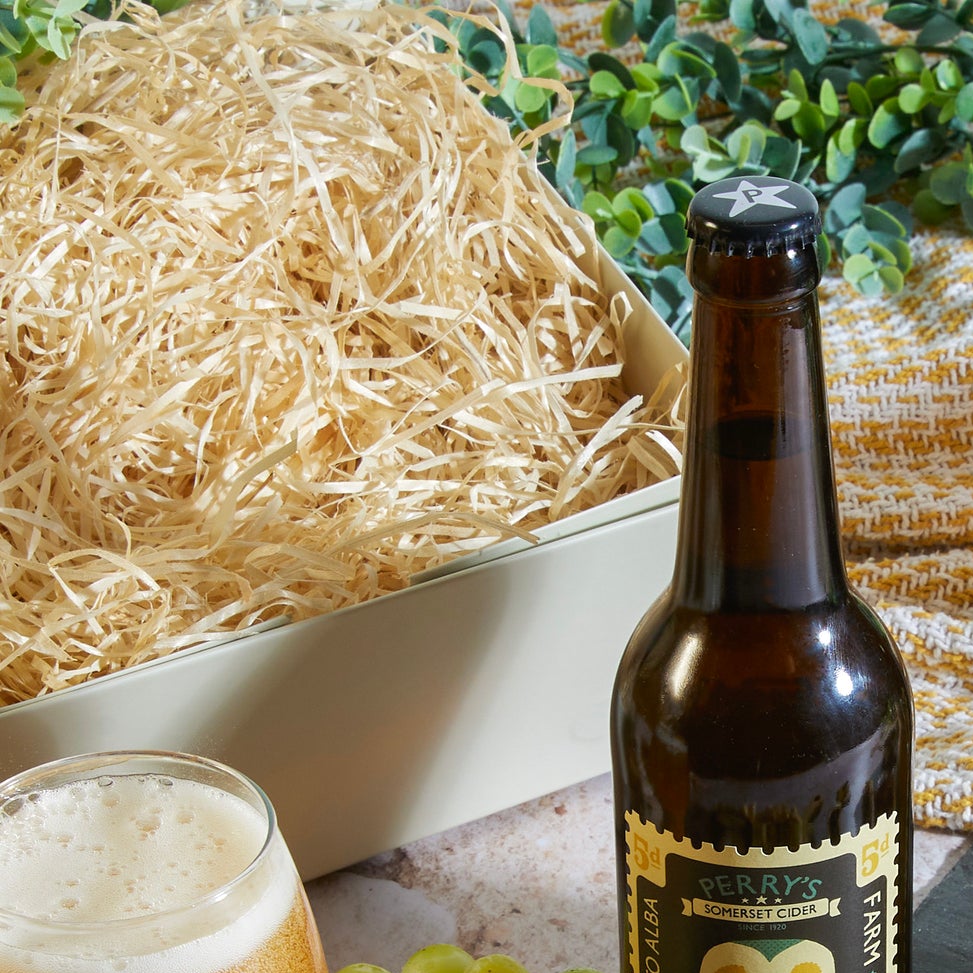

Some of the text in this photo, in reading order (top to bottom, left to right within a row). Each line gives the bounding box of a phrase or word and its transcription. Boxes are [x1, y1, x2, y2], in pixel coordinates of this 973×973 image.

[741, 189, 763, 204] P
[861, 832, 889, 878] 5d
[699, 874, 823, 900] PERRY'S
[704, 904, 817, 919] SOMERSET CIDER
[643, 898, 660, 955] ALBA
[769, 923, 787, 931] 1920
[863, 890, 882, 967] FARM
